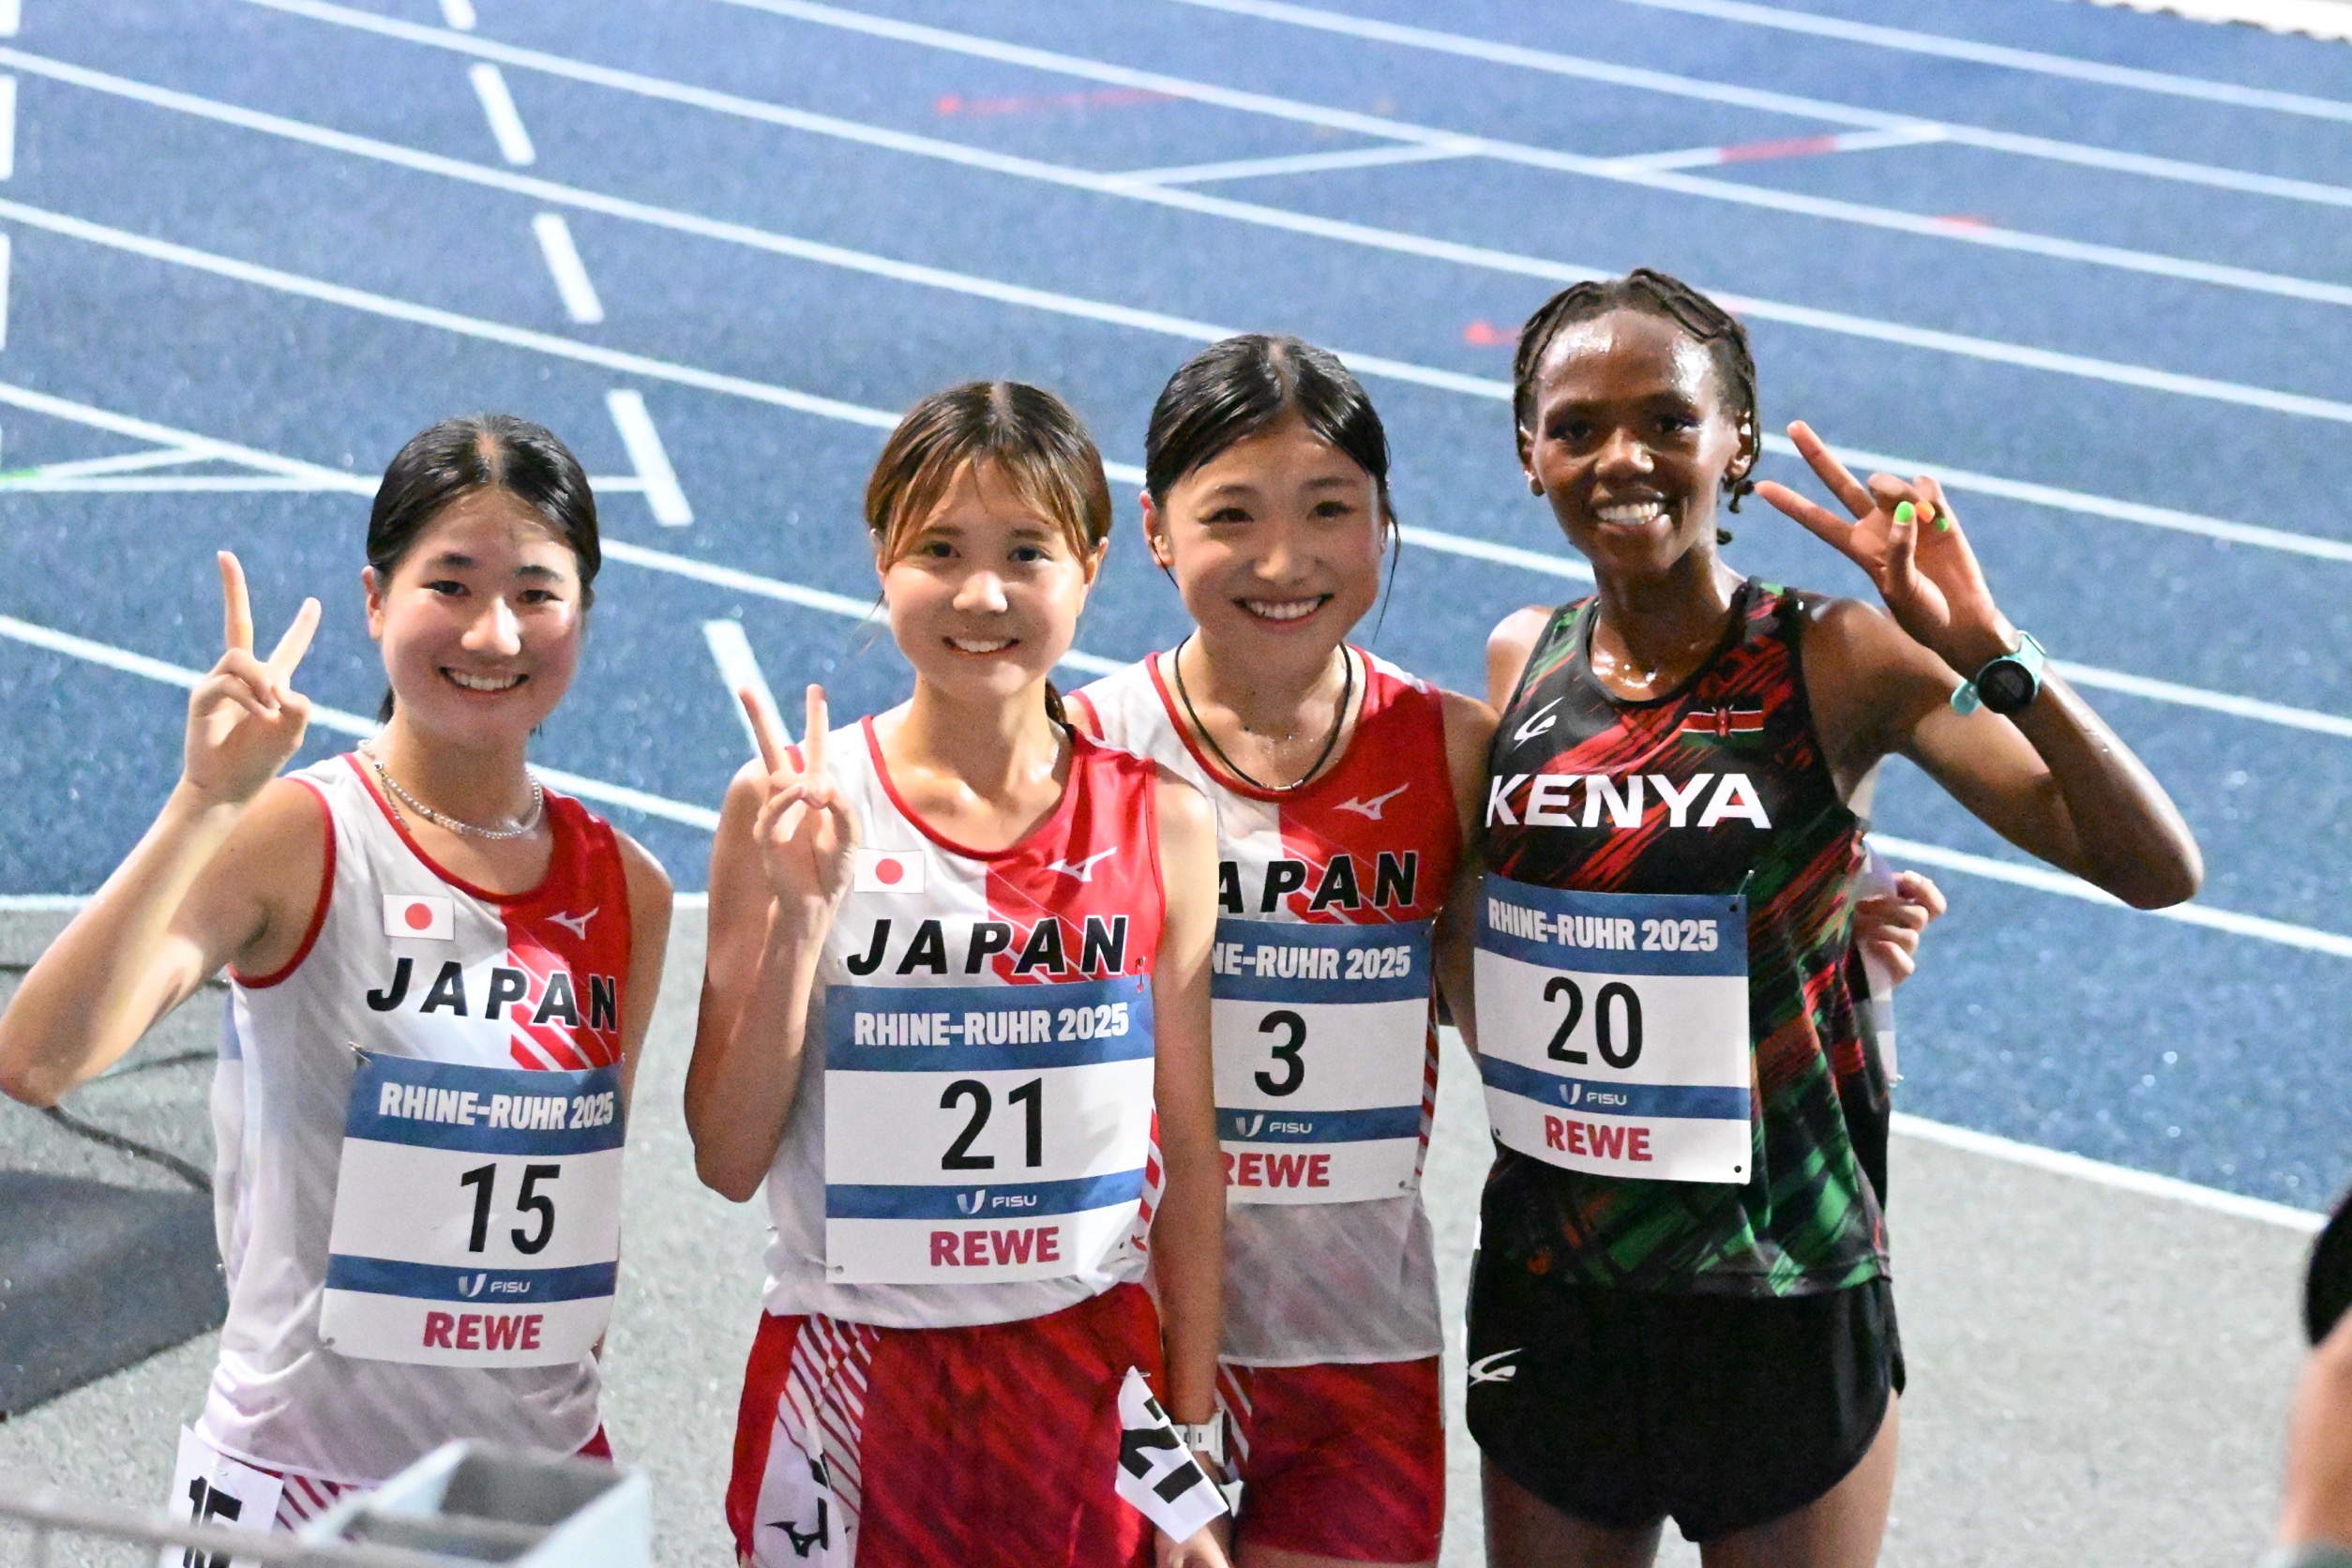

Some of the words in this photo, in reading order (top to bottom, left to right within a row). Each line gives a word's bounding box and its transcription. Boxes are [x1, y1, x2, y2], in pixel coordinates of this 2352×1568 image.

[1485, 773, 1772, 830] KENYA
[1218, 850, 1419, 914] APAN
[846, 914, 1129, 976] JAPAN
[1487, 897, 1636, 951] RHINE-RUHR
[1641, 919, 1719, 952] 2025
[1212, 942, 1338, 980] NE-RUHR
[1344, 945, 1411, 980] 2025
[366, 957, 618, 1033] JAPAN
[854, 1010, 1052, 1047] RHINE-RUHR
[1057, 1002, 1129, 1042] 2025
[1544, 976, 1643, 1069] 20
[1254, 1009, 1306, 1097] 3
[378, 1081, 568, 1131] RHINE-RUHR
[569, 1091, 614, 1130] 2025
[939, 1077, 1042, 1170] 21
[1586, 1091, 1628, 1106] FISU
[1269, 1121, 1313, 1135] FISU
[1544, 1114, 1652, 1162] REWE
[460, 1163, 561, 1255] 15
[991, 1194, 1038, 1209] FISU
[929, 1226, 1060, 1267] REWE
[490, 1280, 532, 1294] FISU
[423, 1311, 544, 1350] REWE
